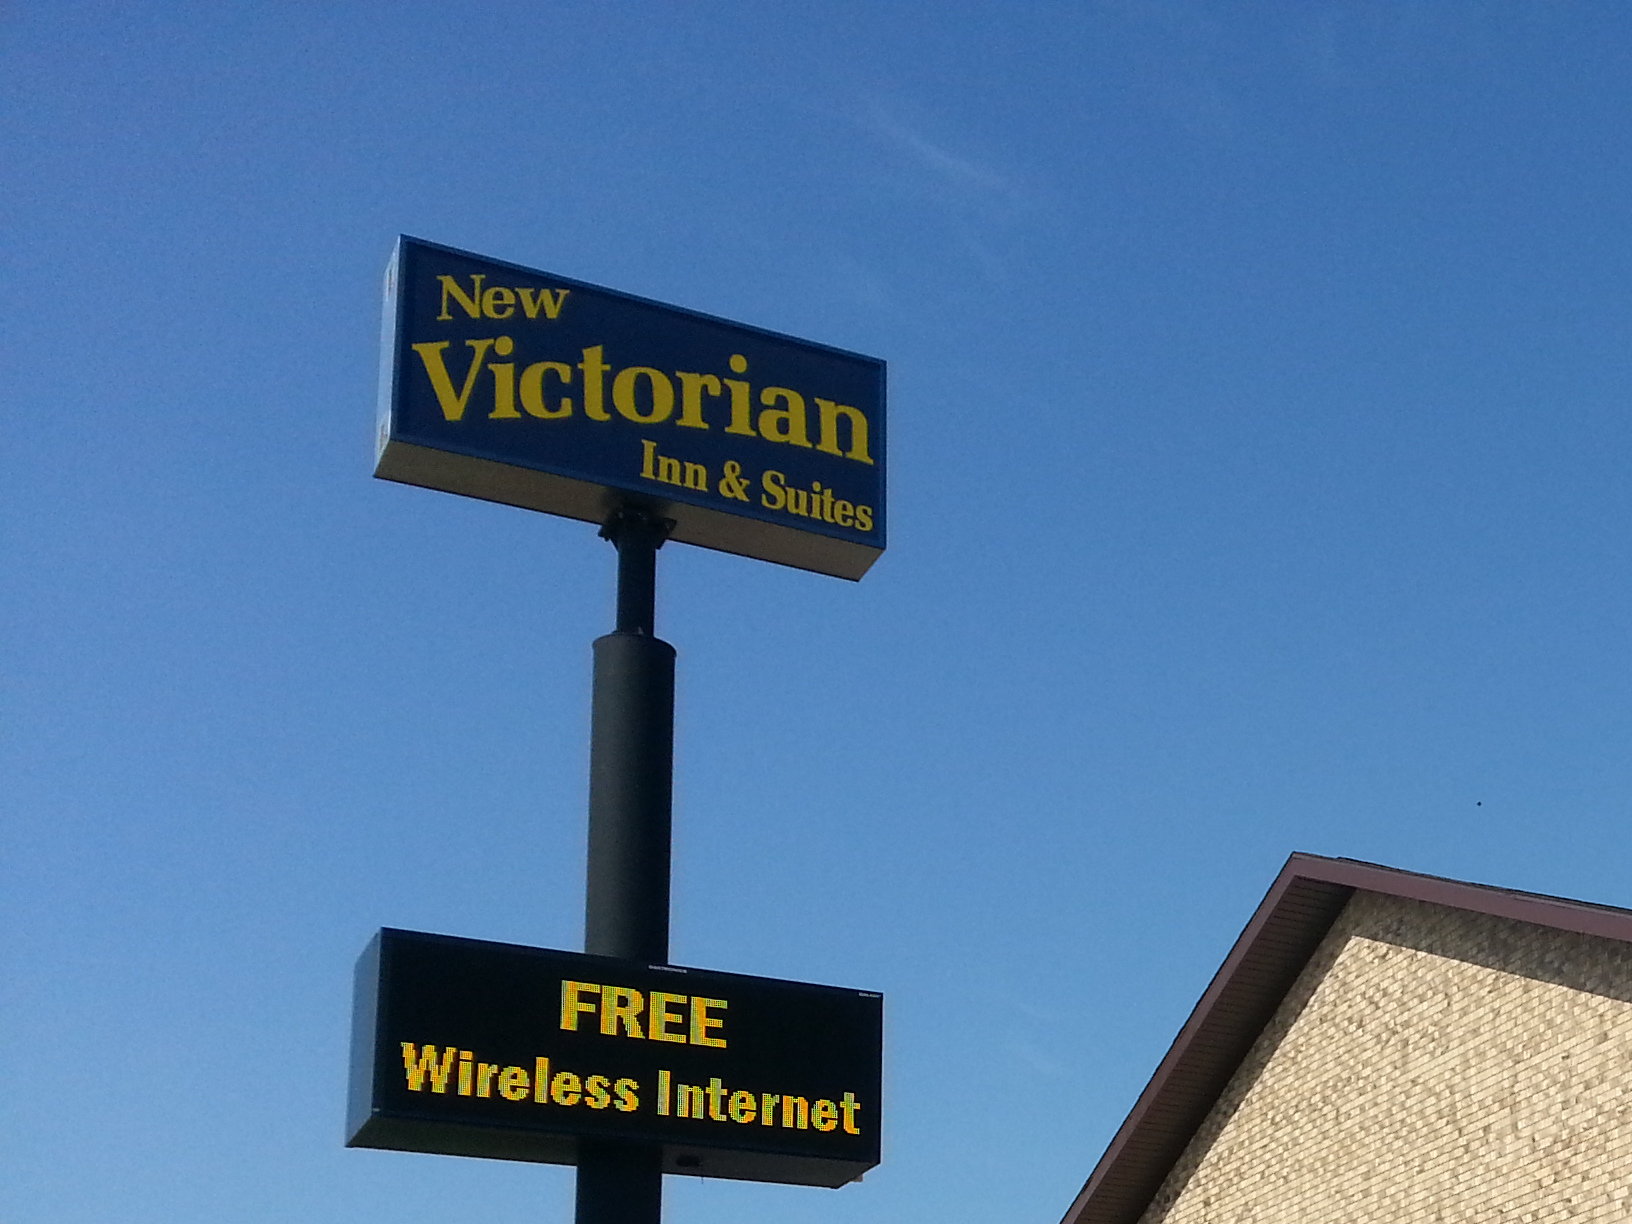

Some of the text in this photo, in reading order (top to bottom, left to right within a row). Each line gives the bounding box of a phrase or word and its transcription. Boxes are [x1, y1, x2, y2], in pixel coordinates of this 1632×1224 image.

[436, 274, 570, 320] New
[412, 336, 874, 465] Victorian
[640, 438, 873, 532] Inn & Suites
[560, 980, 728, 1048] FREE
[401, 1041, 861, 1135] Wireless Internet
